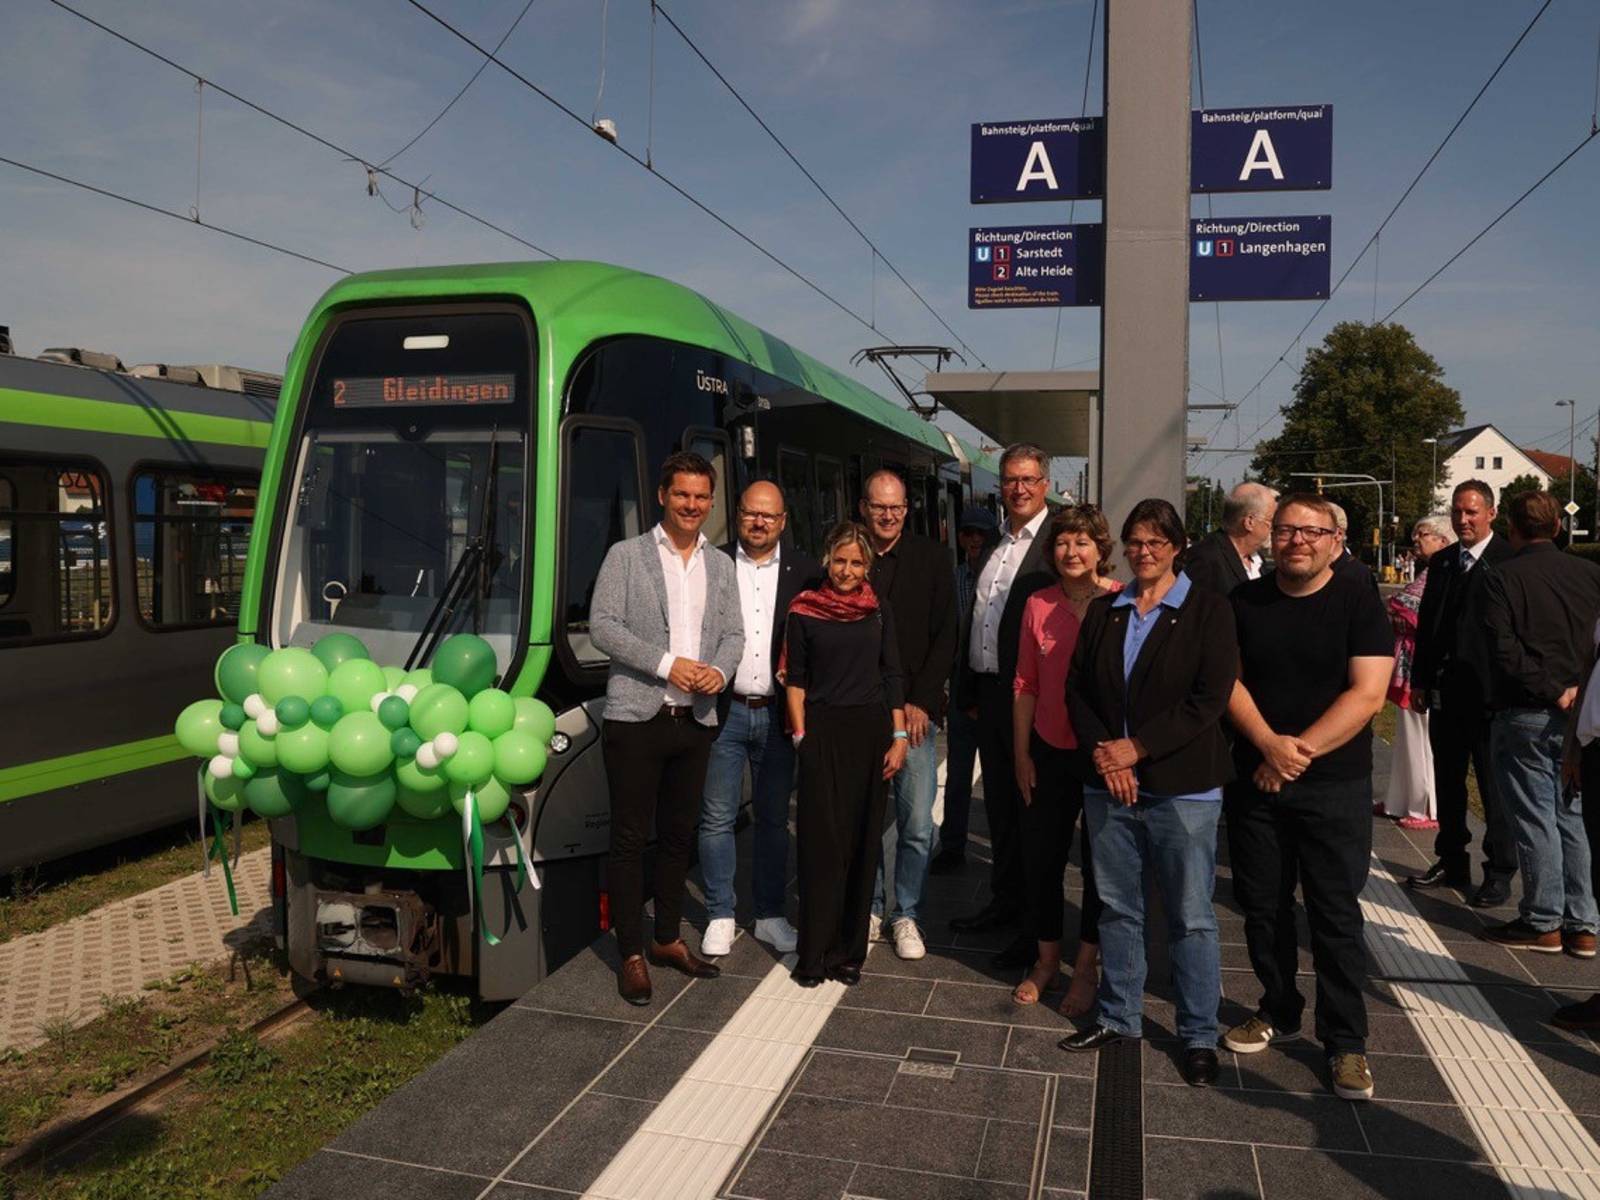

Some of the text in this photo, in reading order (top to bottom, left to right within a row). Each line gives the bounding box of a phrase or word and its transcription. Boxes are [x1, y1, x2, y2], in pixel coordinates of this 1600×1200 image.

[1202, 109, 1323, 123] Bahnsteig/platform/quai
[981, 121, 1094, 136] Bahnsteig/platform/quai
[1239, 129, 1284, 181] A
[1016, 141, 1059, 191] A
[1196, 222, 1300, 236] Richtung/Direction
[975, 230, 1073, 244] Richtung/Direction
[977, 246, 989, 261] U
[1016, 247, 1063, 259] Sarstedt
[1198, 241, 1211, 256] U
[1239, 241, 1326, 256] Langenhagen
[1015, 266, 1038, 277] Alte
[1040, 265, 1073, 276] Heide
[333, 375, 509, 404] 2 Gleidingen
[697, 369, 729, 395] ÜSTRA
